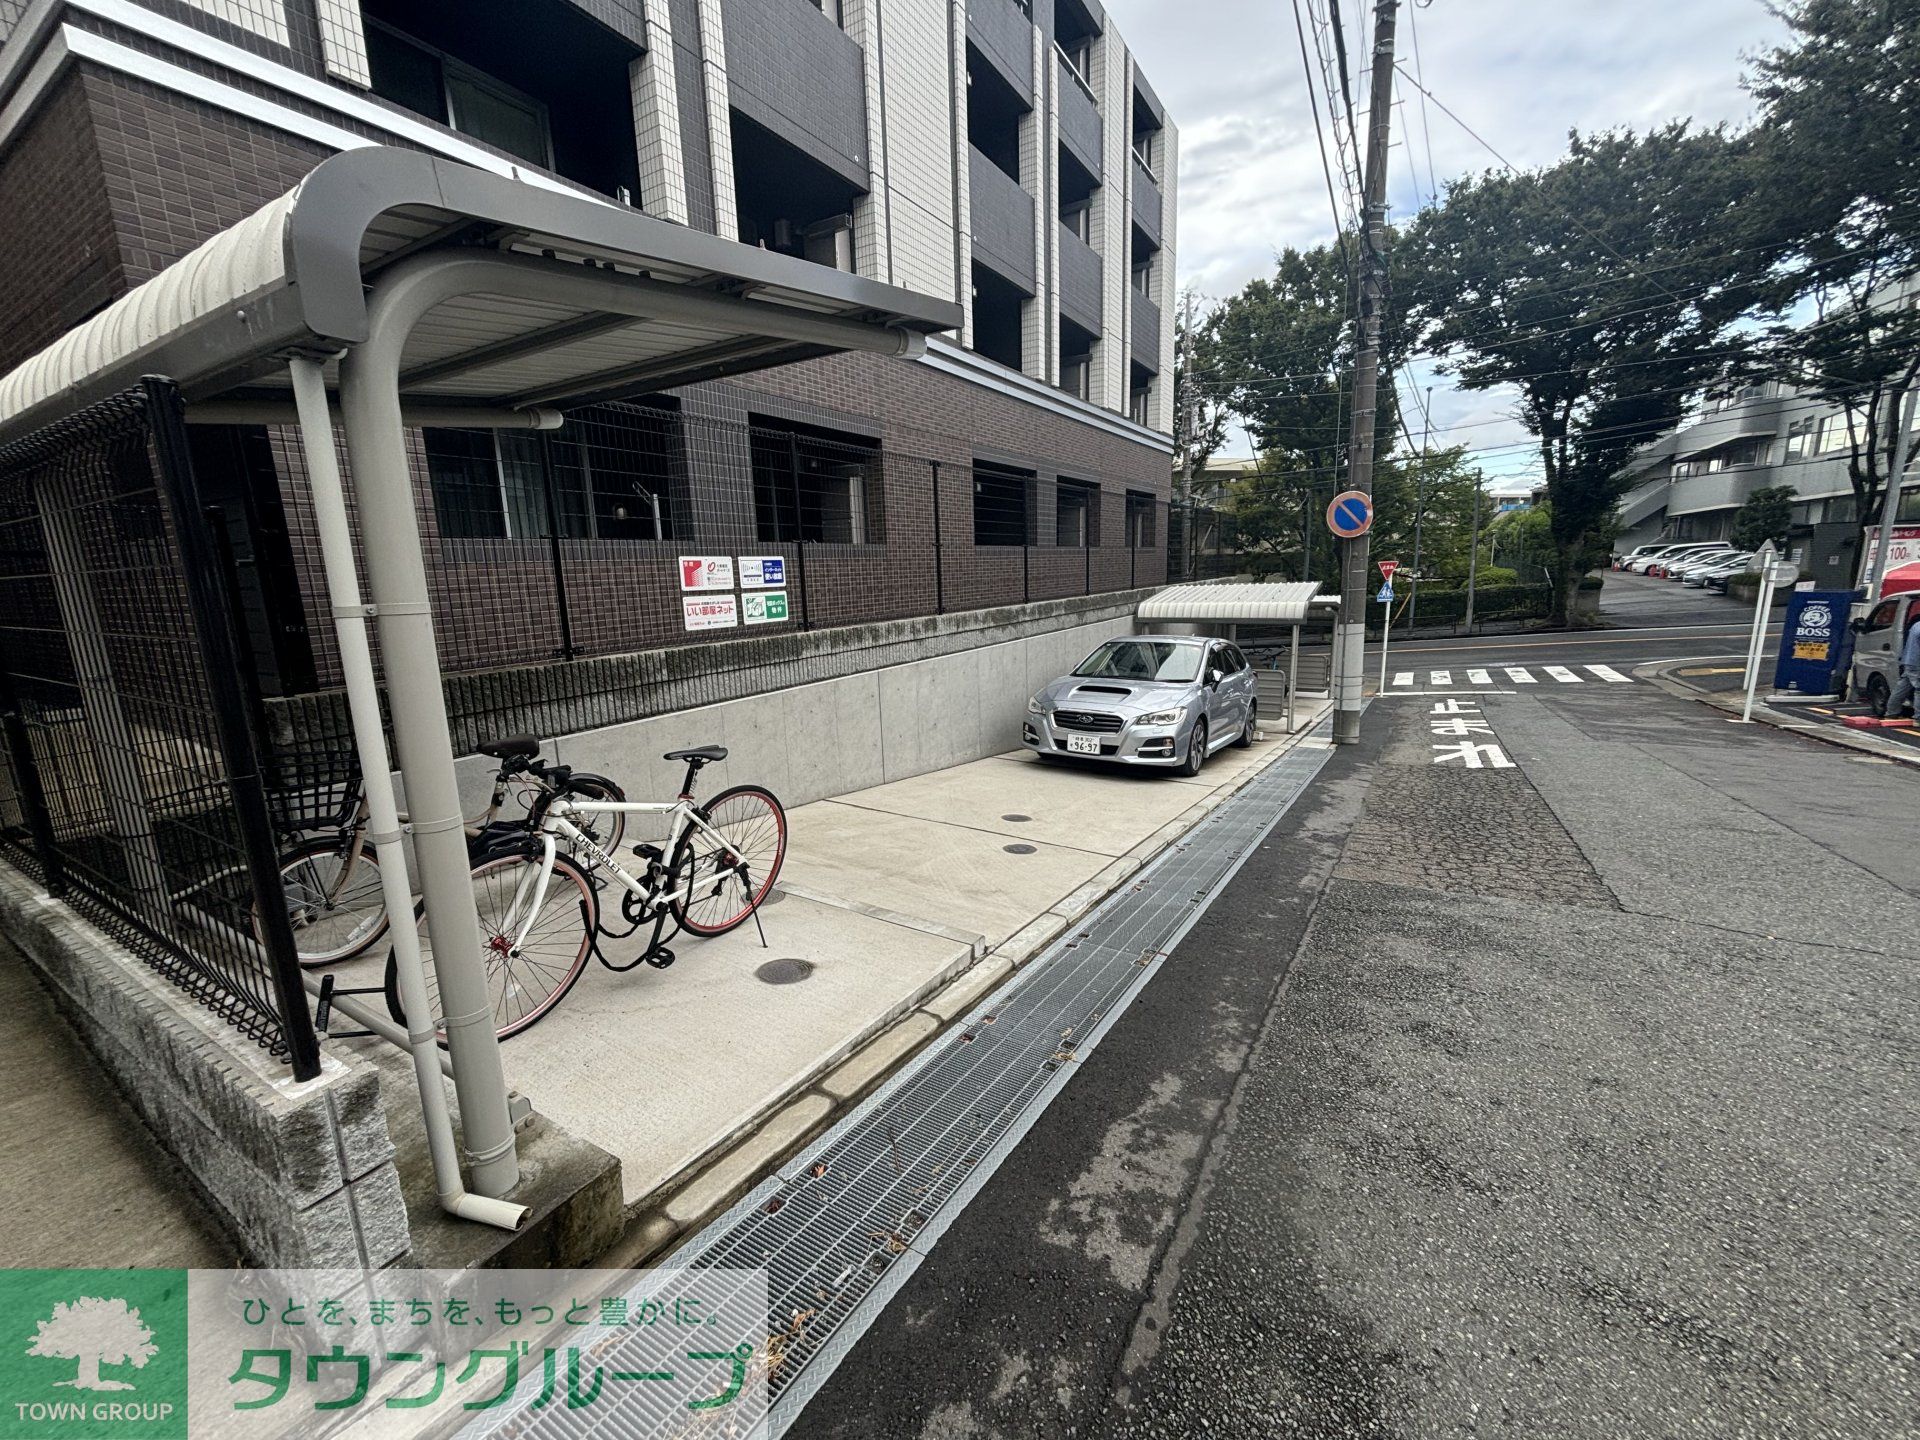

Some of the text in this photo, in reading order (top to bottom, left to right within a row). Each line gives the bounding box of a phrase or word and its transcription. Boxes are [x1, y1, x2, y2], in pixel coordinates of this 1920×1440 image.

[686, 605, 734, 617] いい部屋ネット
[1796, 627, 1831, 637] BOSS
[1074, 742, 1098, 752] 96-97
[576, 834, 621, 874] CHEVROLET
